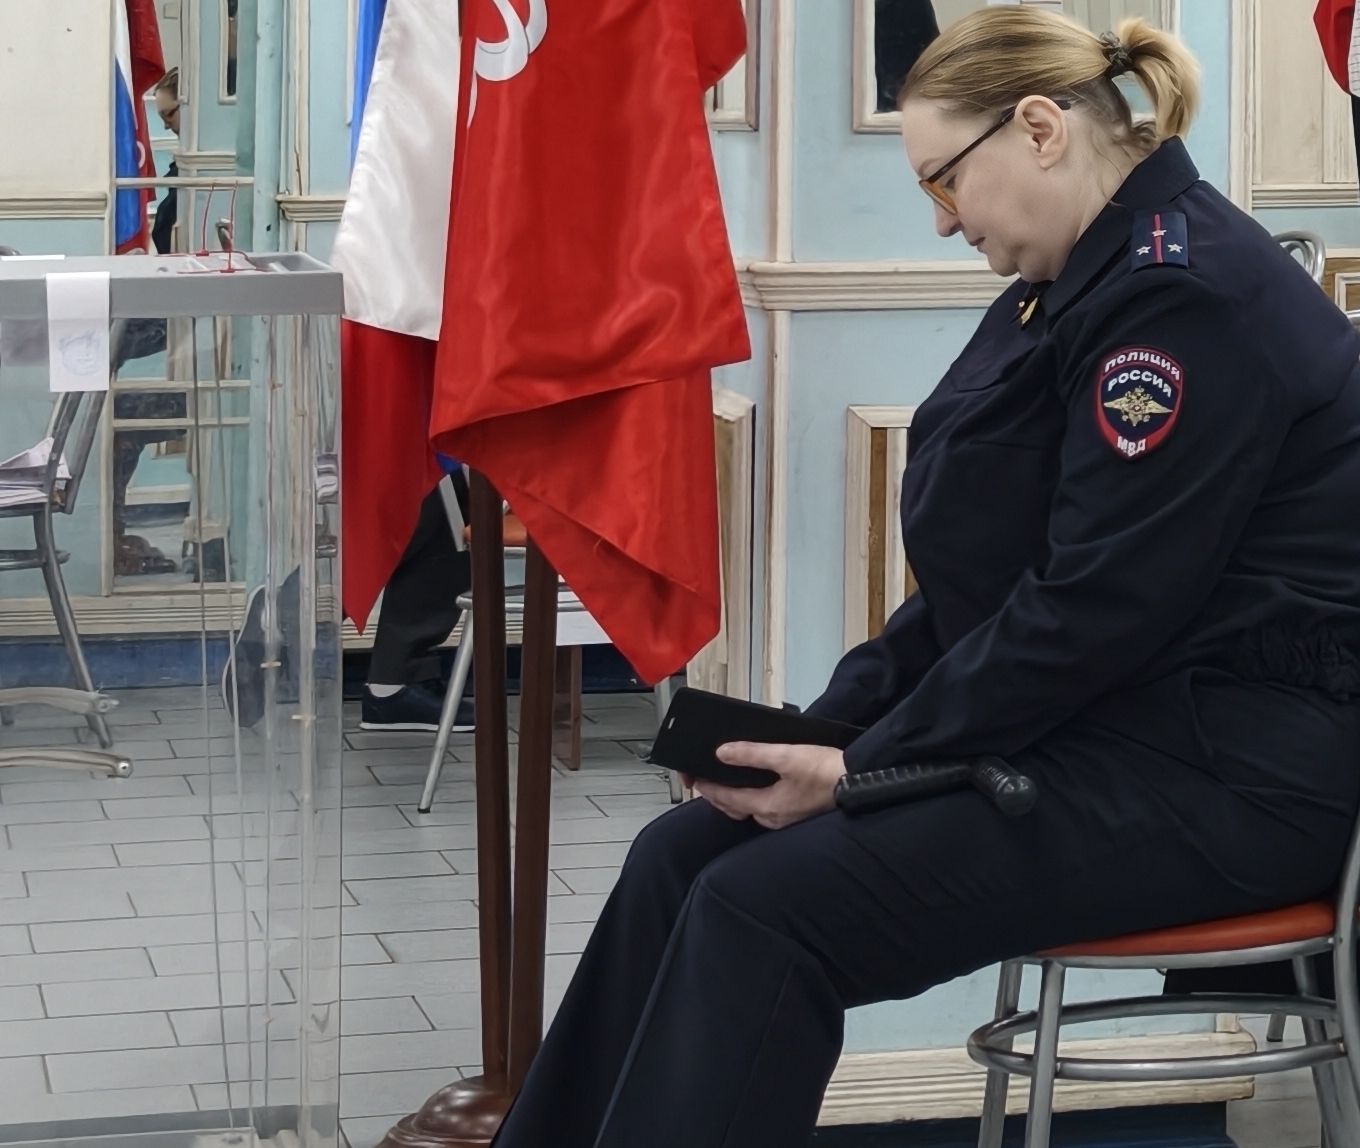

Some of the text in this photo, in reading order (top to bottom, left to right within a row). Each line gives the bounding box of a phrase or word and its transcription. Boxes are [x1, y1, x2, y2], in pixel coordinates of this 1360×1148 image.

[1104, 351, 1181, 380] ПОЛИЦИЯ
[1107, 369, 1172, 398] РОССИЯ
[1116, 435, 1147, 457] МВД
